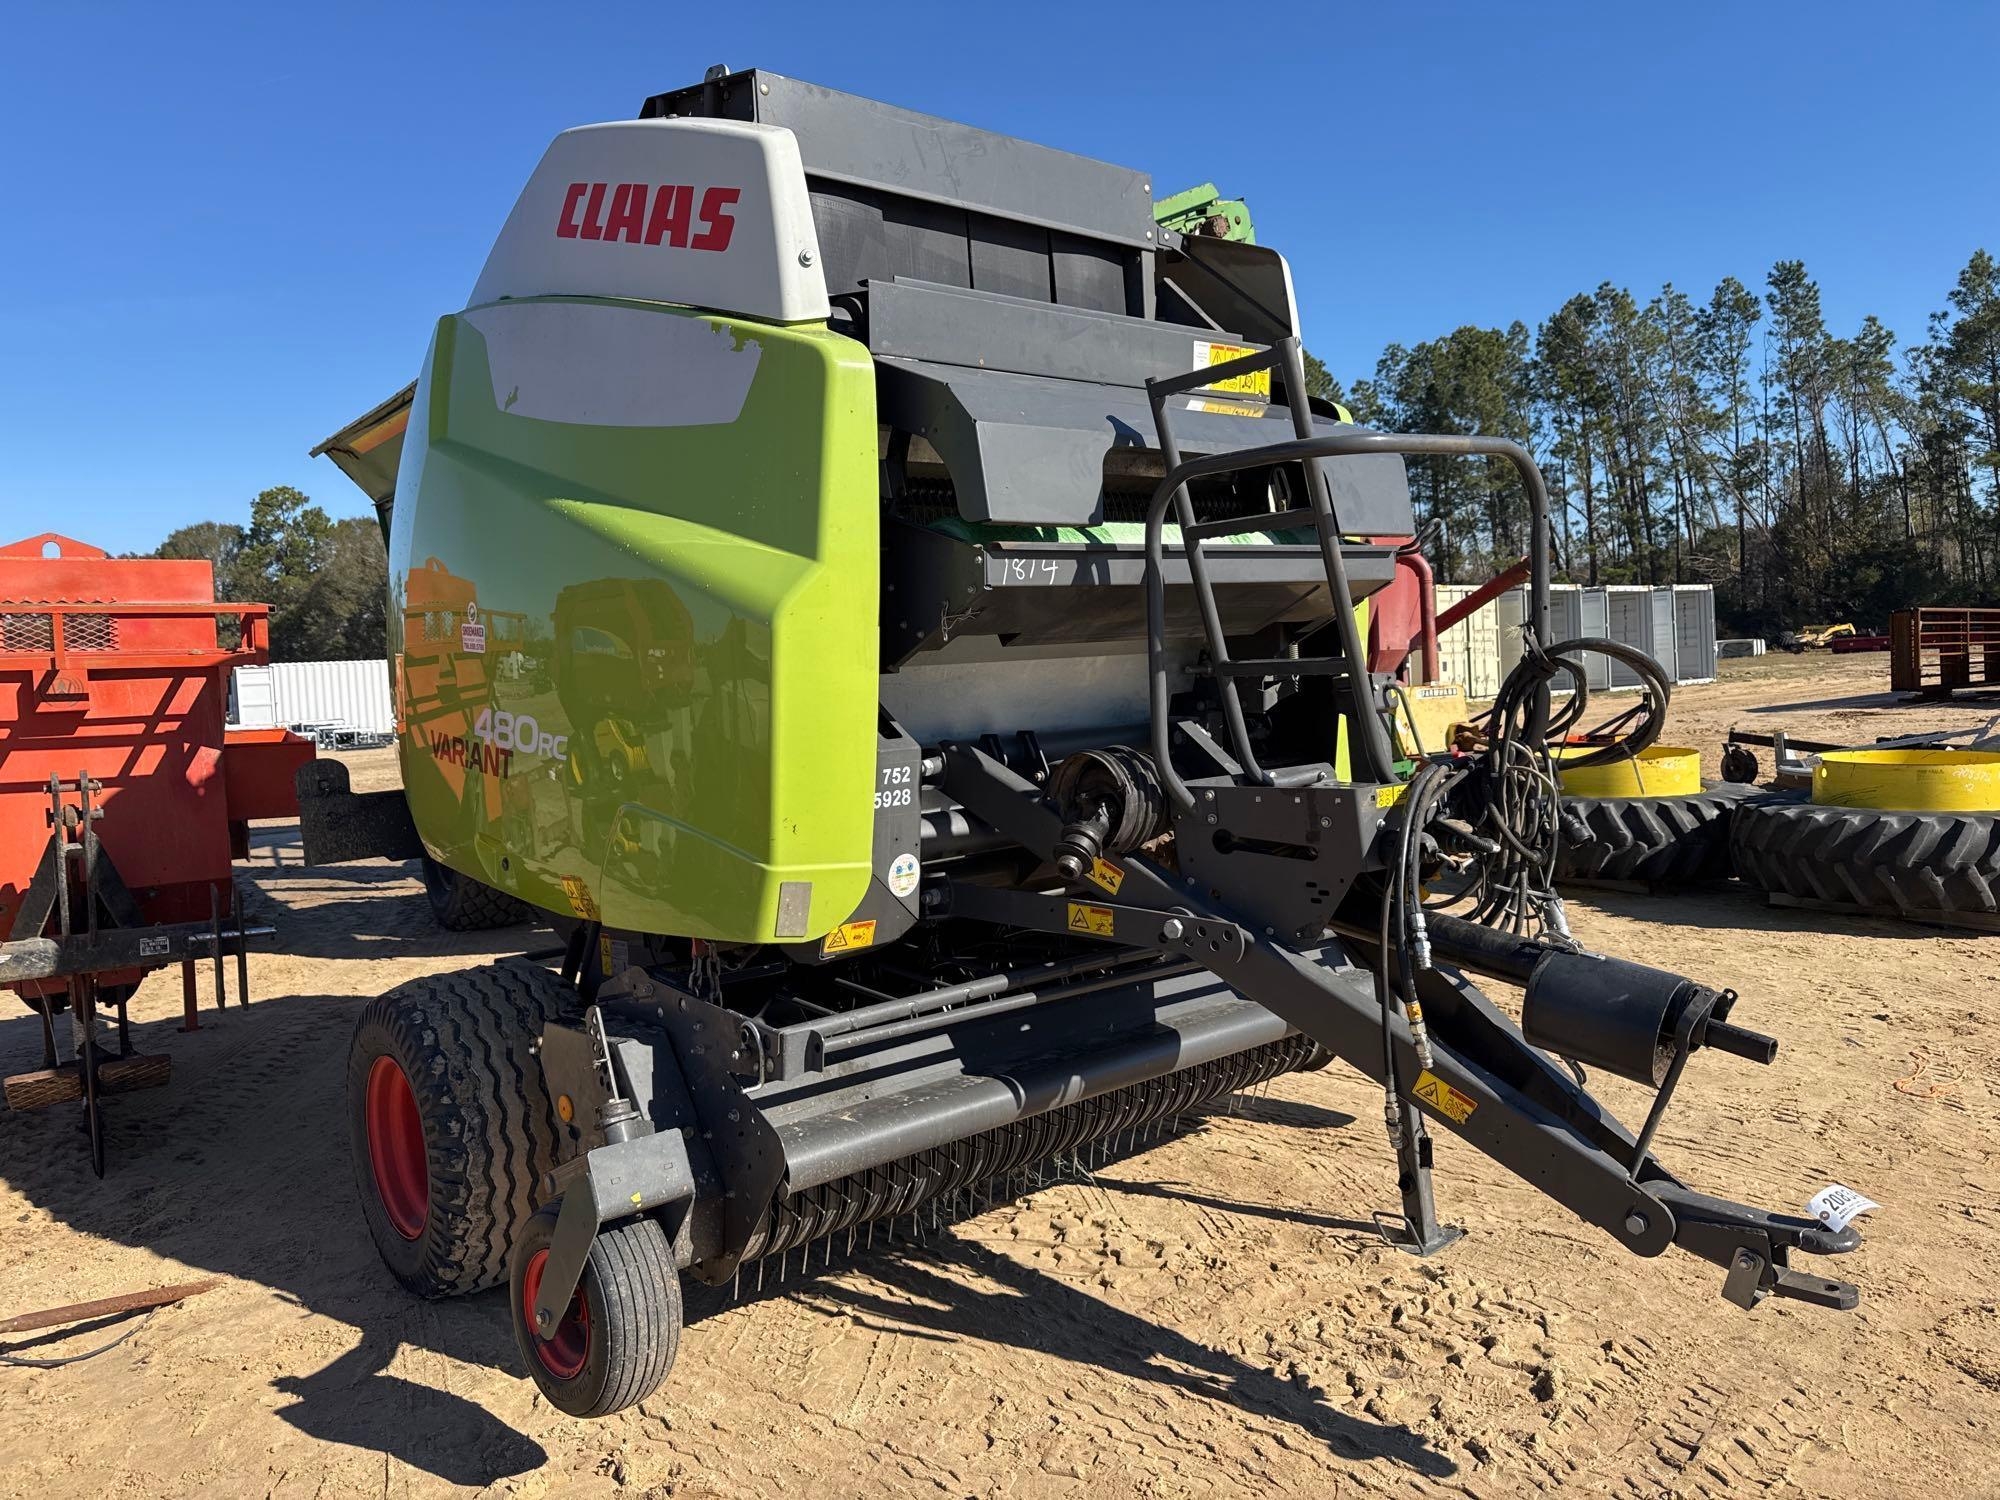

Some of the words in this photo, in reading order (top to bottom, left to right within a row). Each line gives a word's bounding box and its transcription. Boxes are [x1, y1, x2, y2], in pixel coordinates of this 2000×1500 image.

[557, 183, 741, 252] CLAAS
[1003, 558, 1059, 585] 1814
[431, 730, 514, 779] VARIANT
[882, 766, 911, 785] 752
[874, 788, 911, 809] 5928
